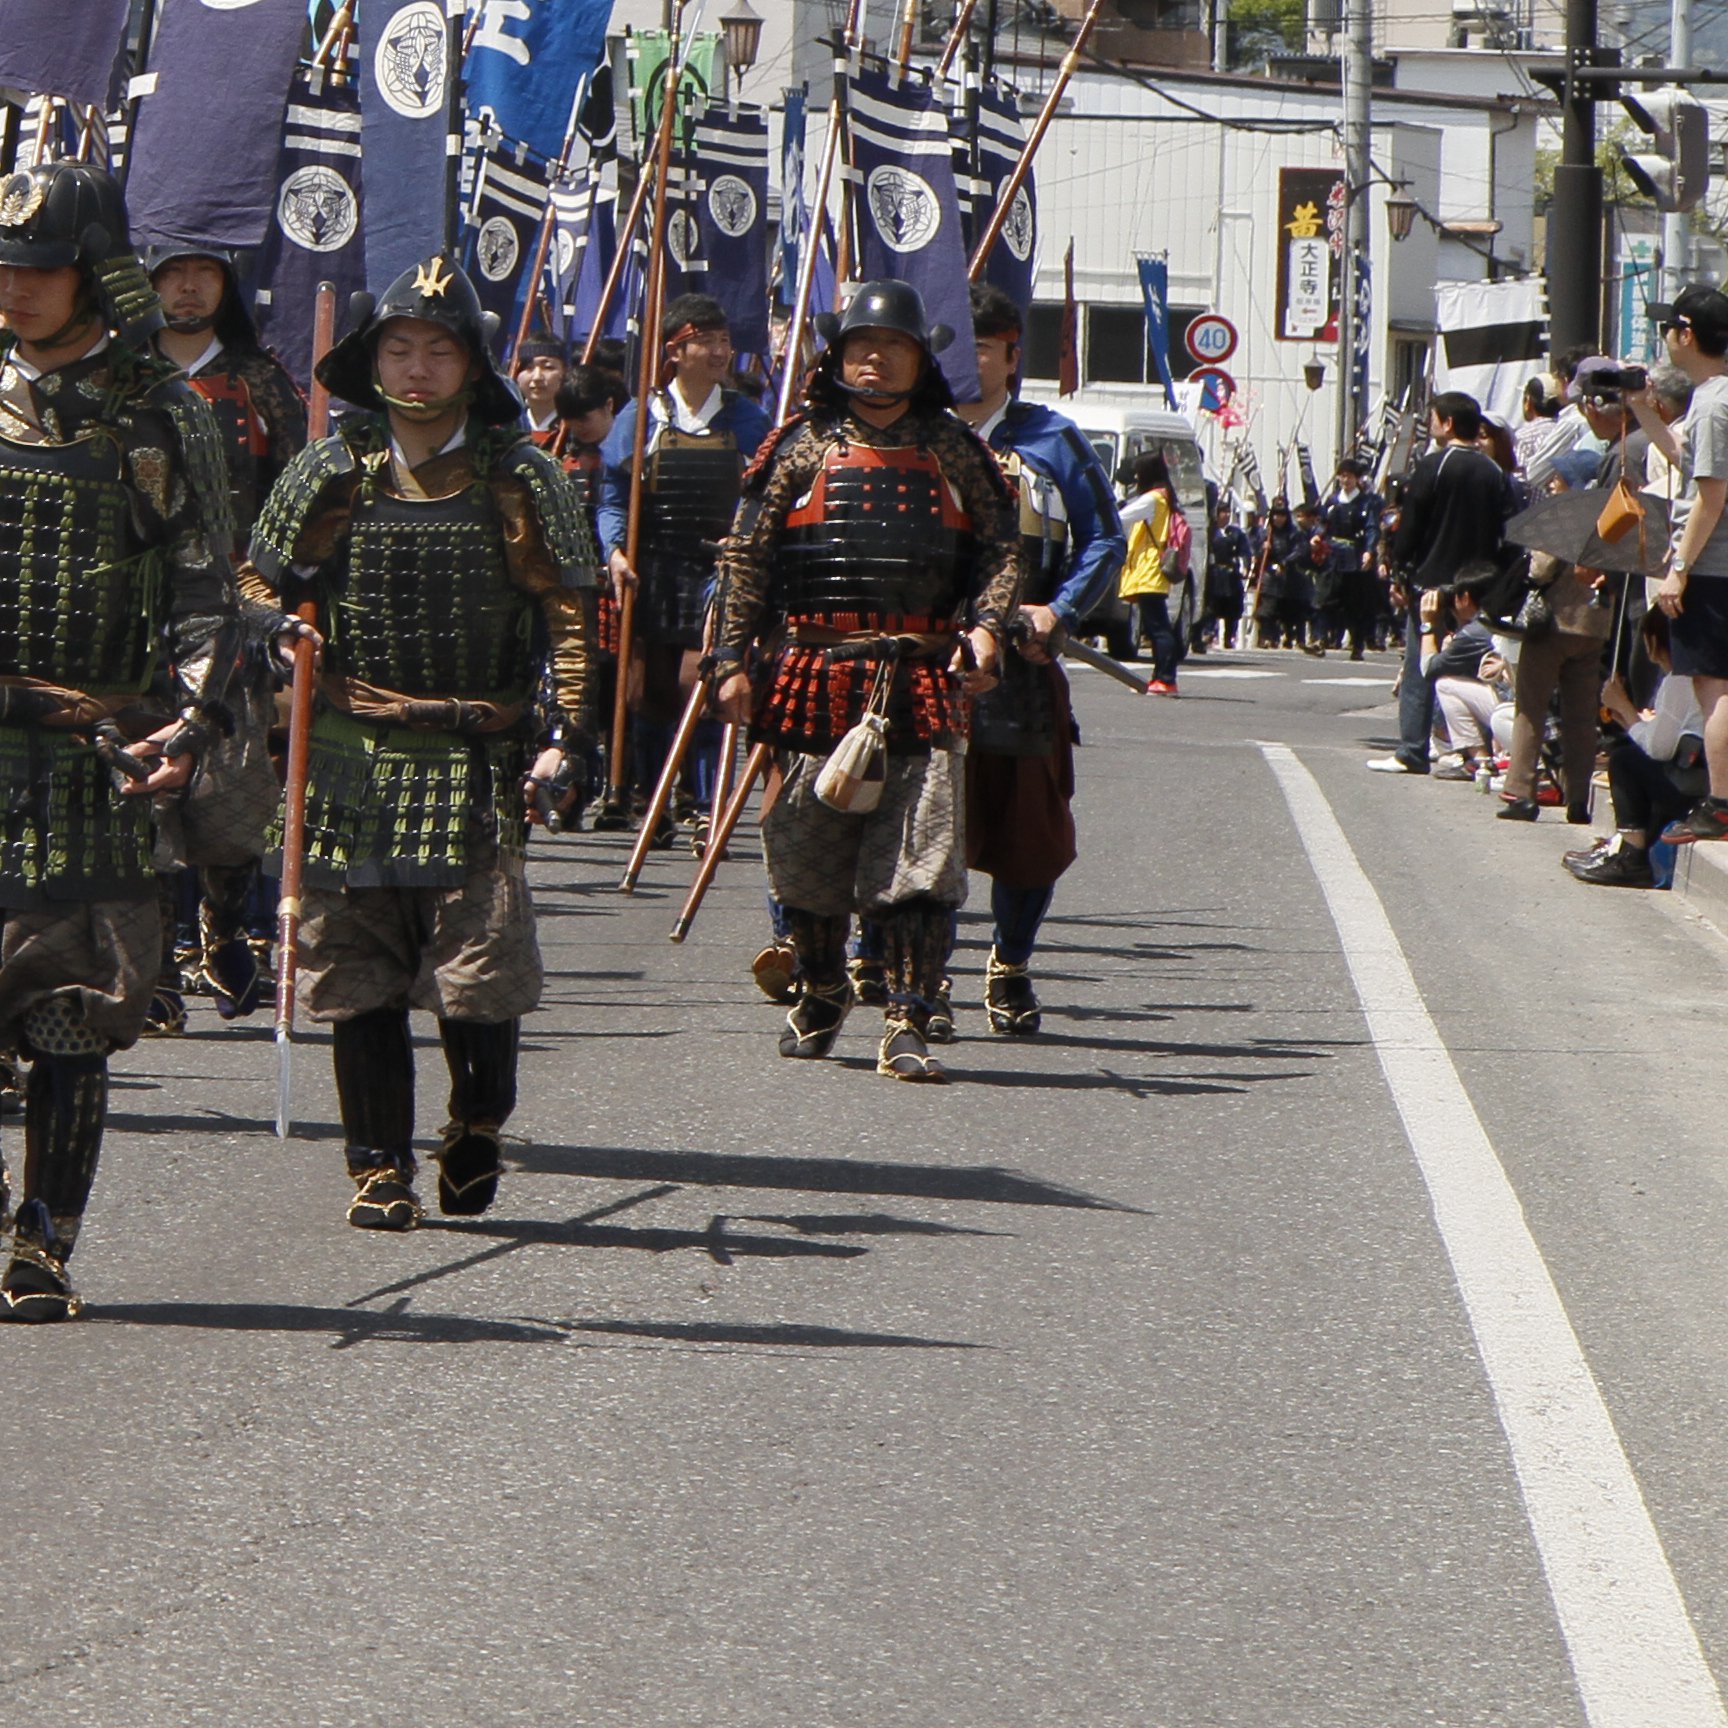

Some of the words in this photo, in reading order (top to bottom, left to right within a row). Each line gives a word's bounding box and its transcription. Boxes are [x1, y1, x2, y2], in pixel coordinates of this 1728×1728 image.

[1300, 243, 1319, 295] 大正寺
[1198, 328, 1227, 350] 40
